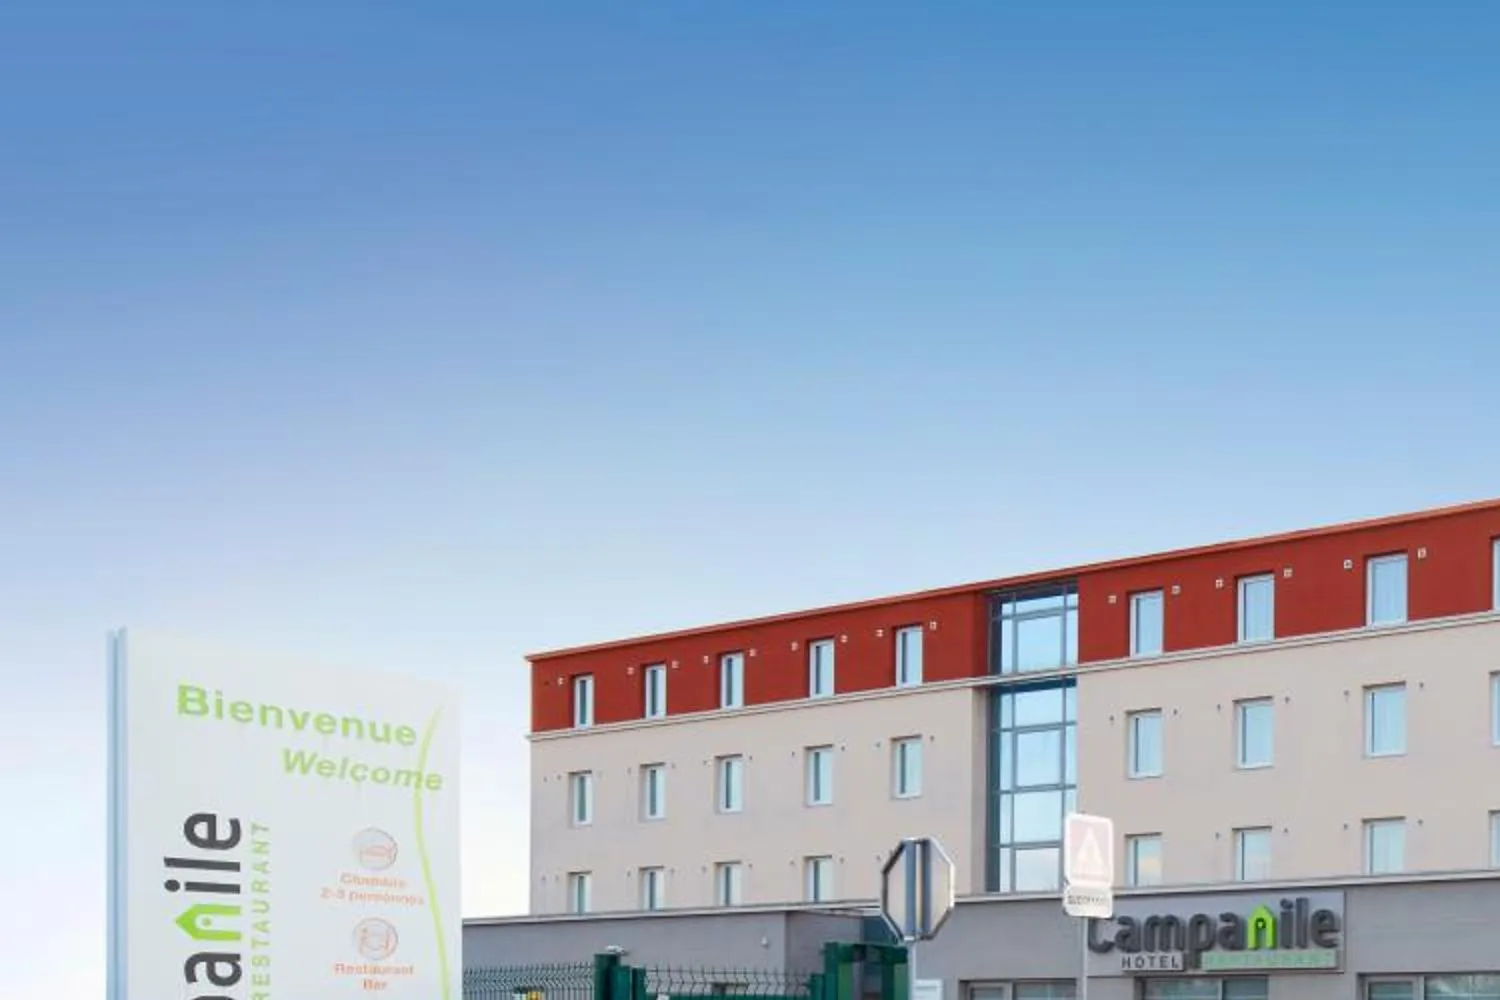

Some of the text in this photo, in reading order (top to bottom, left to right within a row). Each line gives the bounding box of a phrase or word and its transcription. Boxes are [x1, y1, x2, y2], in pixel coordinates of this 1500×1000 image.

[177, 684, 417, 746] Bienvenue
[282, 748, 444, 791] Welcome
[1087, 897, 1340, 970] Campanile
[1121, 954, 1181, 970] HOTEL
